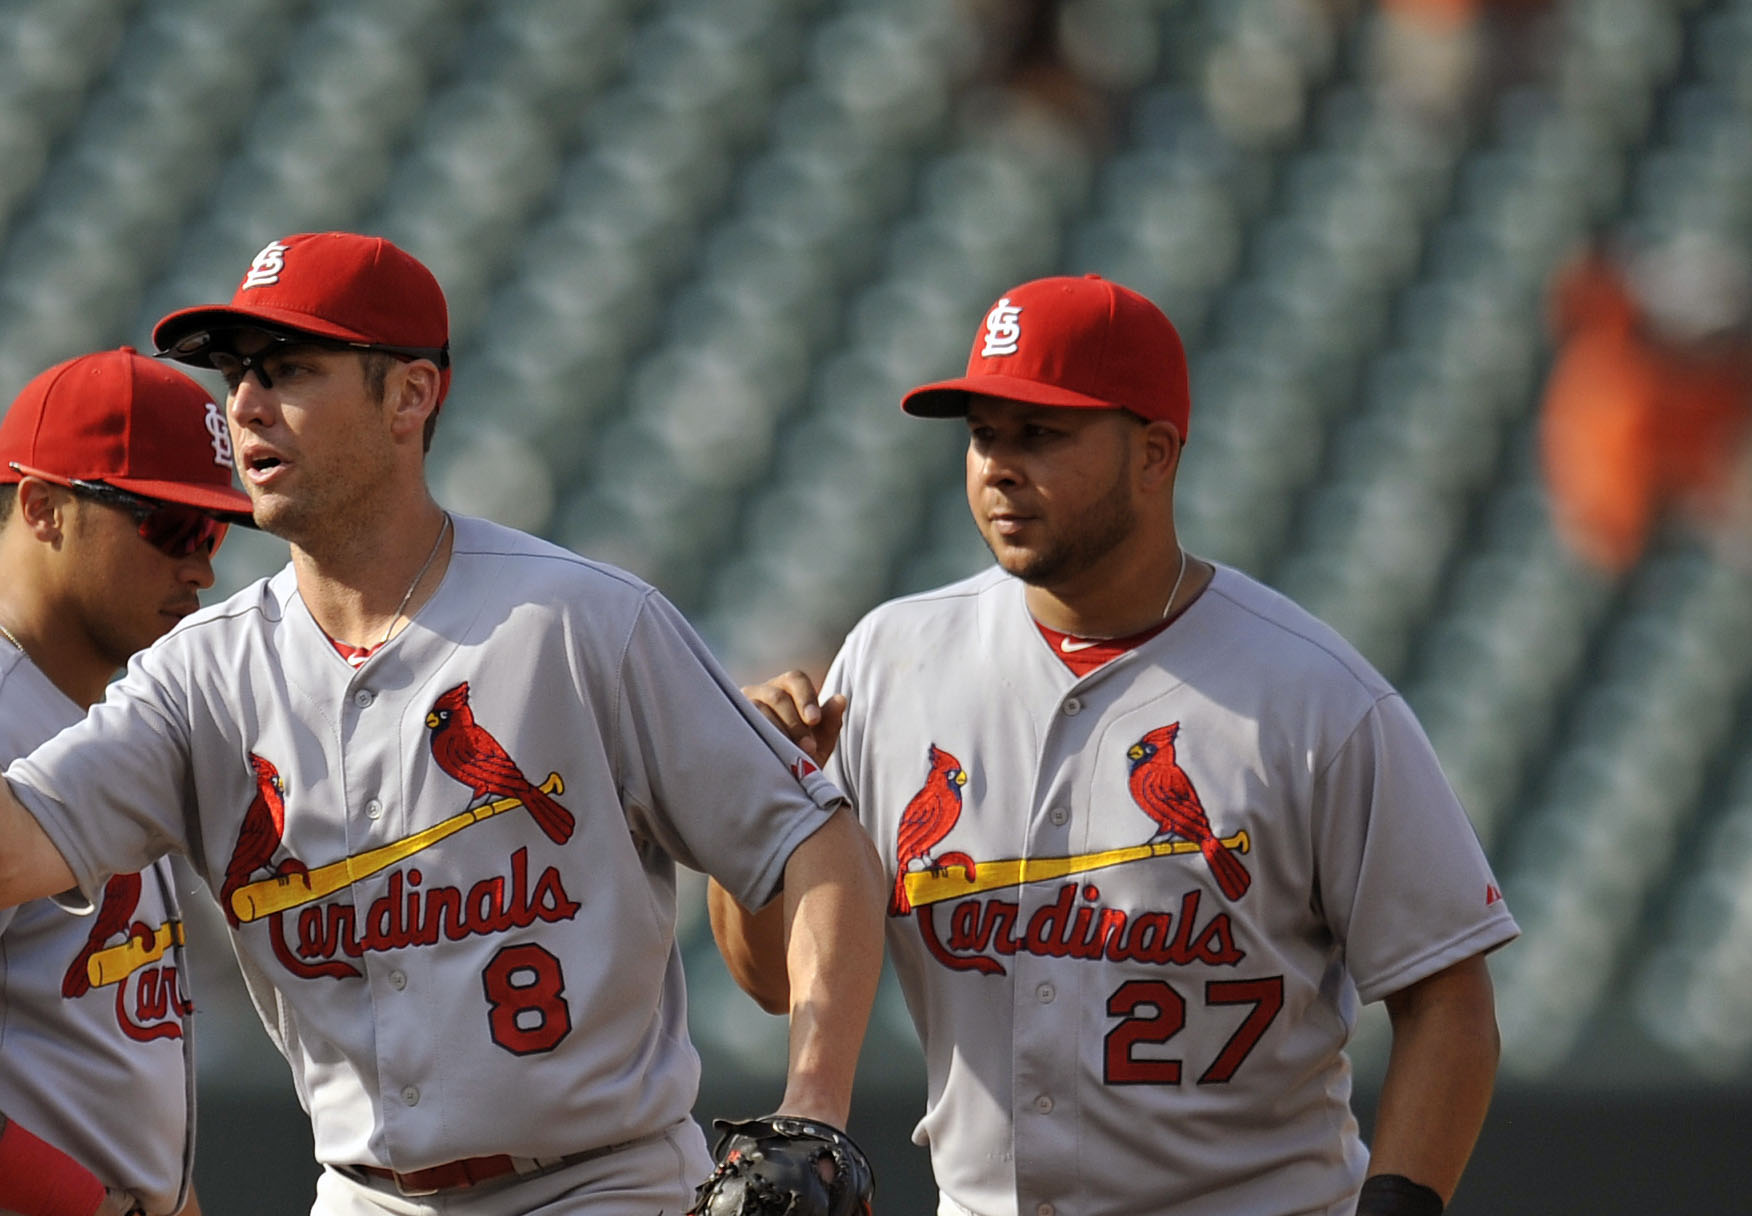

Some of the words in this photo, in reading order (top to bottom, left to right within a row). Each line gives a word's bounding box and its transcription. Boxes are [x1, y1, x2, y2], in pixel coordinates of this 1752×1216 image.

[268, 845, 583, 981] Cardinals
[916, 882, 1247, 977] Cardinals
[481, 941, 573, 1057] 8
[1103, 974, 1285, 1086] 27
